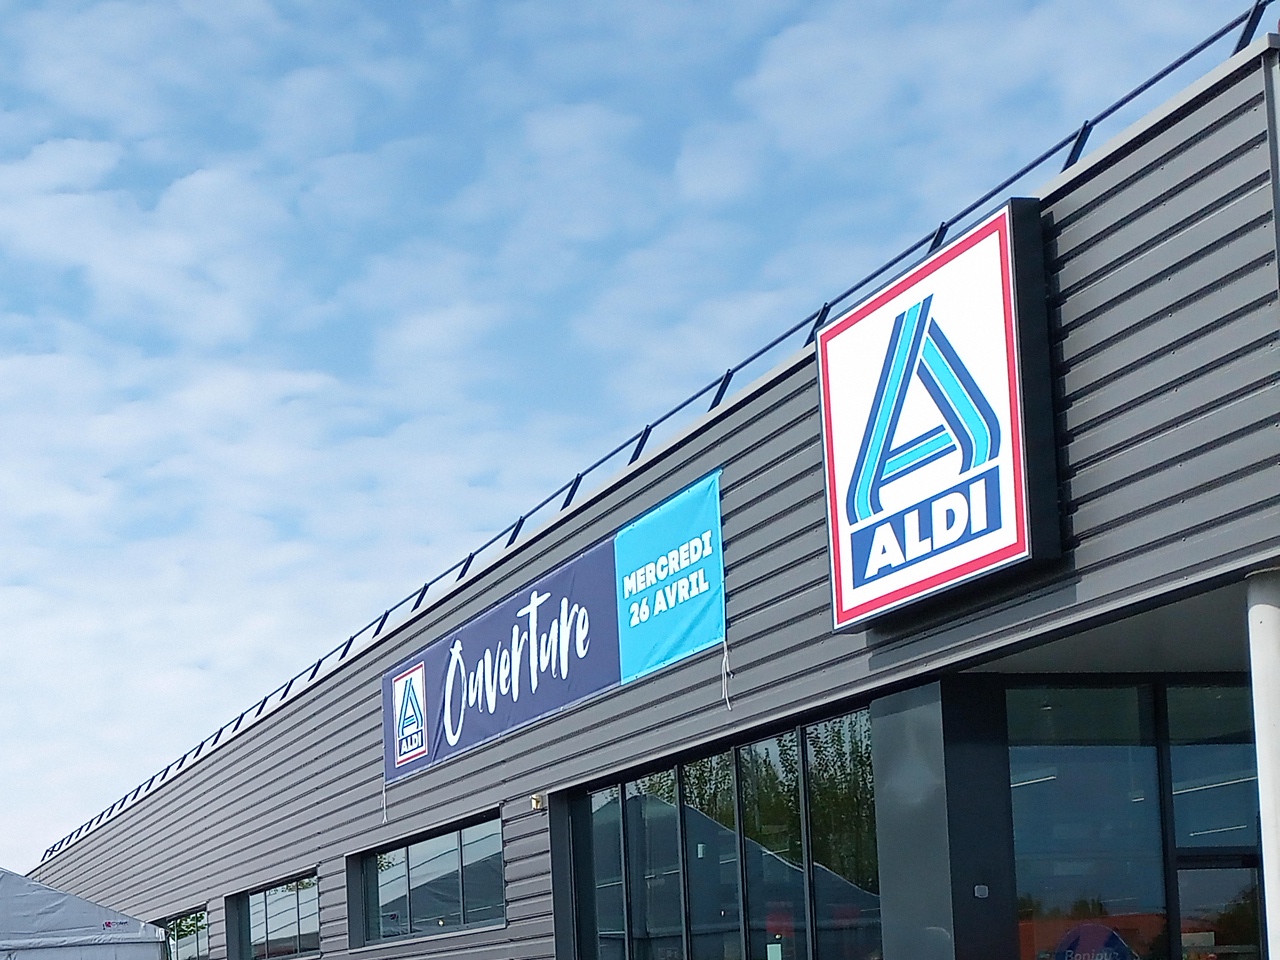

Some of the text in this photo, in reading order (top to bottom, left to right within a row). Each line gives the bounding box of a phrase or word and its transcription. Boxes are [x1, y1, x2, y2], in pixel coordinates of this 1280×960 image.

[863, 477, 989, 580] ALDI
[622, 529, 713, 600] MERCREDI
[629, 567, 711, 628] 26 AVRIL
[443, 590, 591, 747] Ouverture
[400, 732, 422, 755] ALDI
